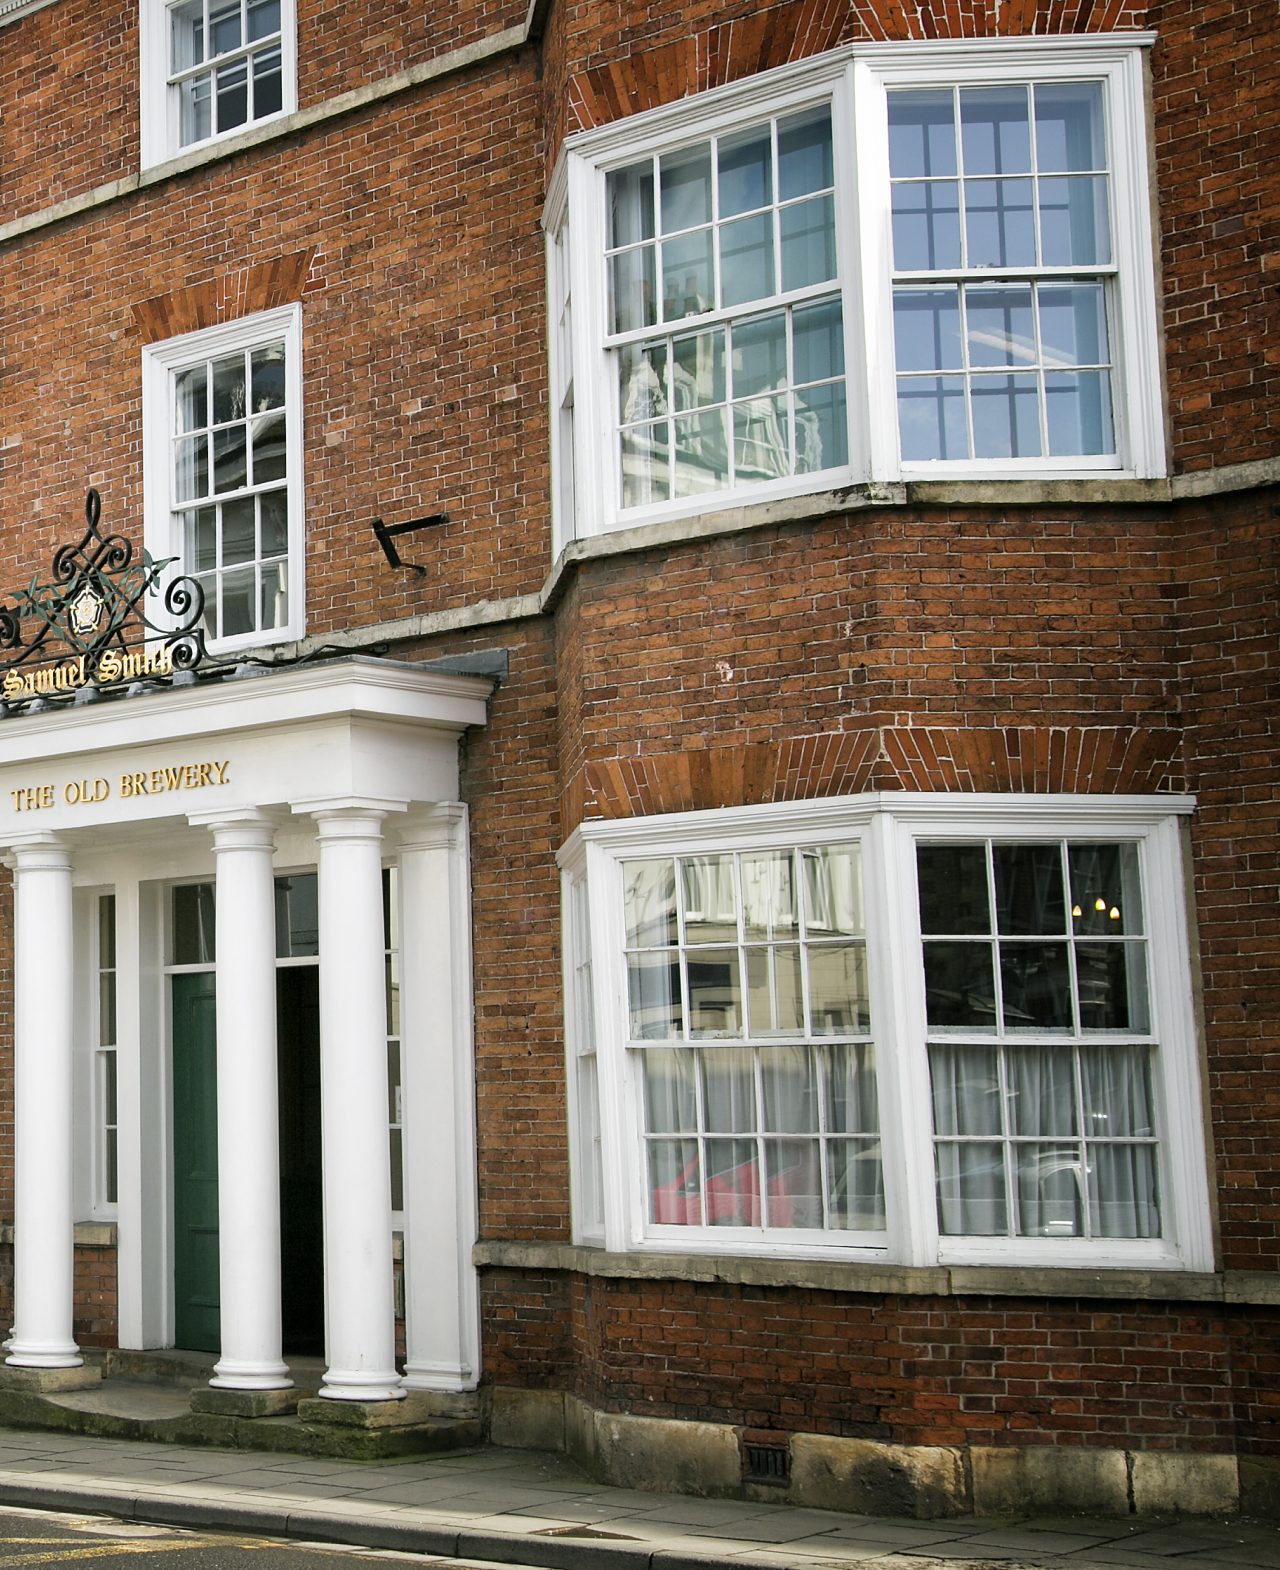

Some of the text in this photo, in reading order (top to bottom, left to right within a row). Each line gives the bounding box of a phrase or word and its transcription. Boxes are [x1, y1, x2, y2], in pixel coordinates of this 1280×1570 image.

[2, 640, 174, 701] Samuel Smith
[10, 784, 55, 812] THE
[63, 778, 110, 805] OLD
